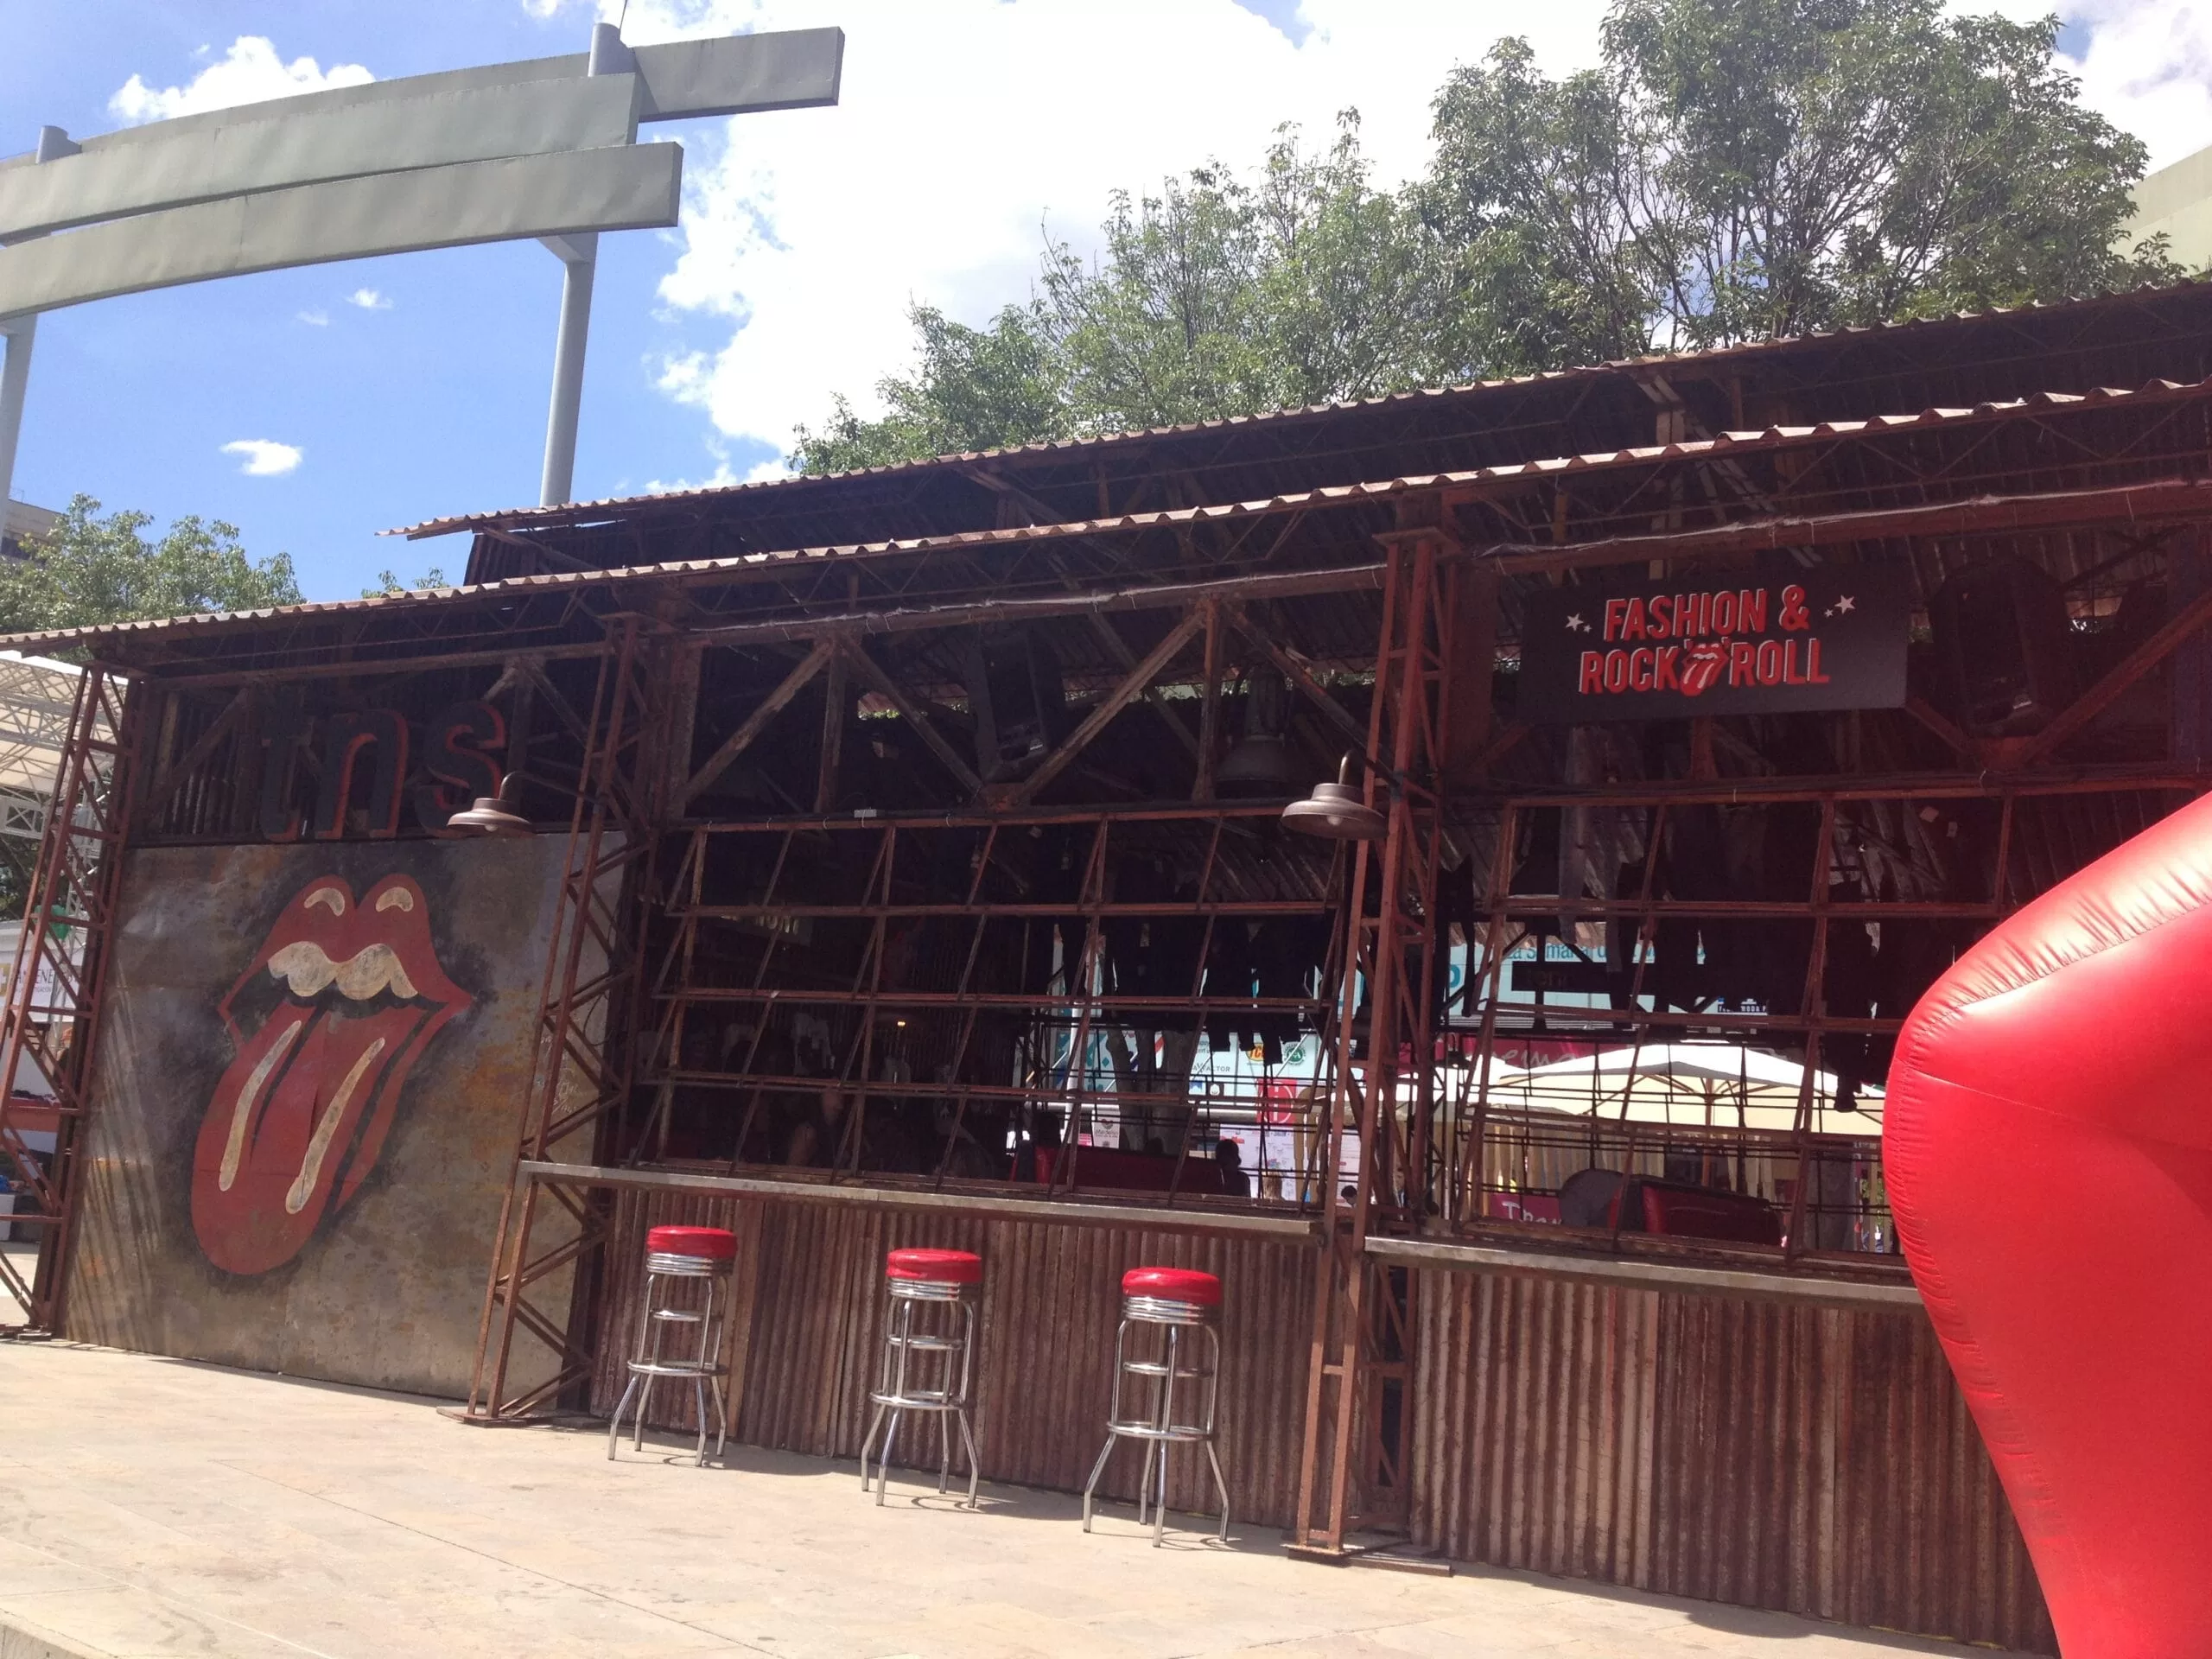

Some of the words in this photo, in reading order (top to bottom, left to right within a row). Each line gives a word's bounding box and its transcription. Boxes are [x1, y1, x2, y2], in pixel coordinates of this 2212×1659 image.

[1603, 587, 1769, 642] FASHION
[1778, 583, 1811, 632] &
[1578, 644, 1681, 696] ROCK
[1728, 638, 1832, 688] ROLL
